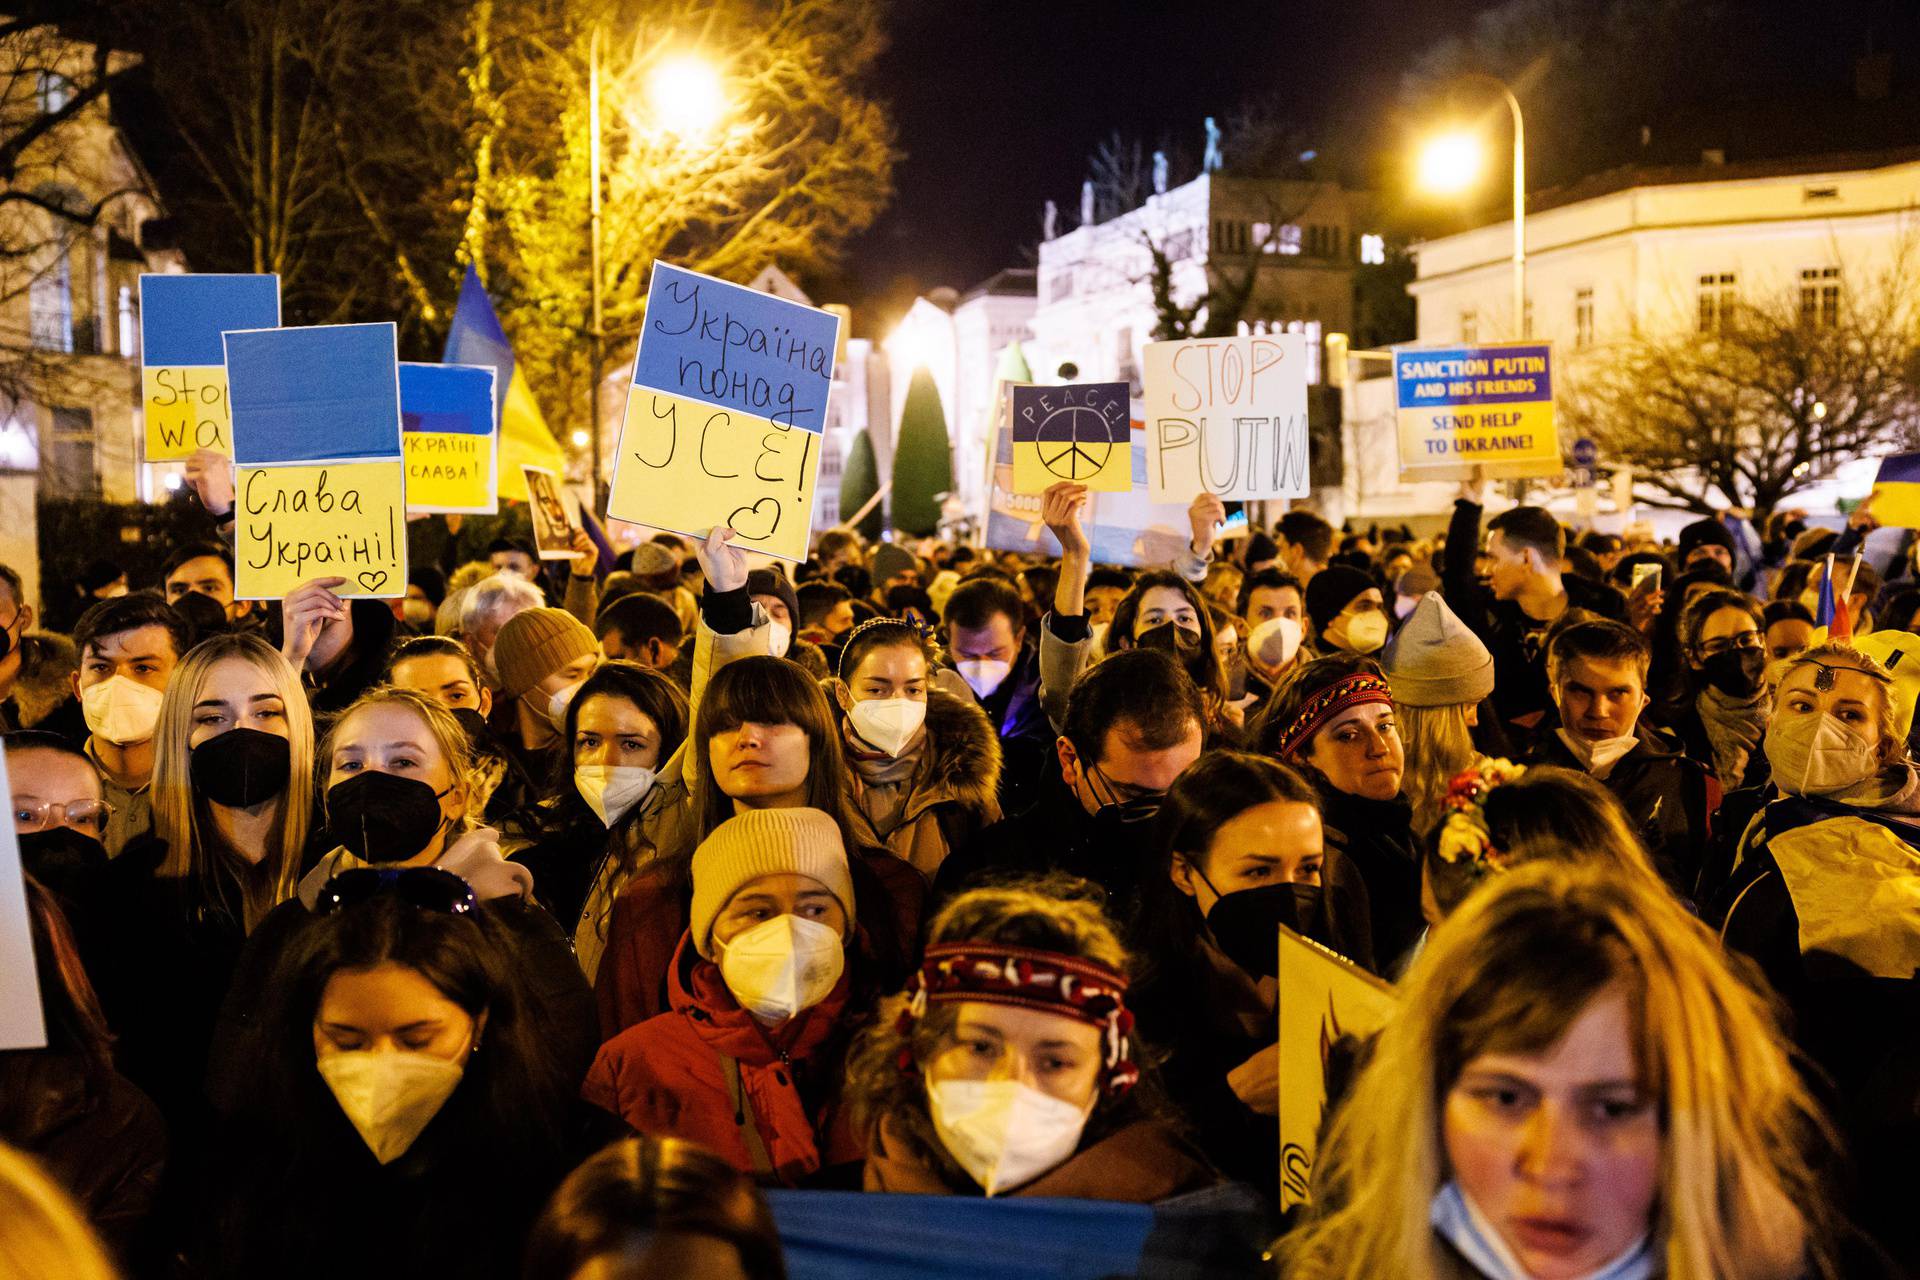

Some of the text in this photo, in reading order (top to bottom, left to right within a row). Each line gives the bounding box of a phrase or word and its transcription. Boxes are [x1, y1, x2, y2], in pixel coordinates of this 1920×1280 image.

[654, 281, 832, 379] Україна
[1172, 339, 1284, 412] STOP
[1400, 356, 1547, 381] SANCTION PUTIN
[1414, 378, 1537, 399] AND HIS FRIENDS
[679, 356, 814, 432] понад
[1021, 388, 1125, 425] PEACE!
[159, 419, 226, 449] wa
[1432, 411, 1523, 430] SEND HELP
[1157, 413, 1308, 496] PUTIN
[1425, 434, 1534, 454] TO UKRAINE!
[246, 469, 362, 515] Слава
[247, 505, 396, 578] Україні!
